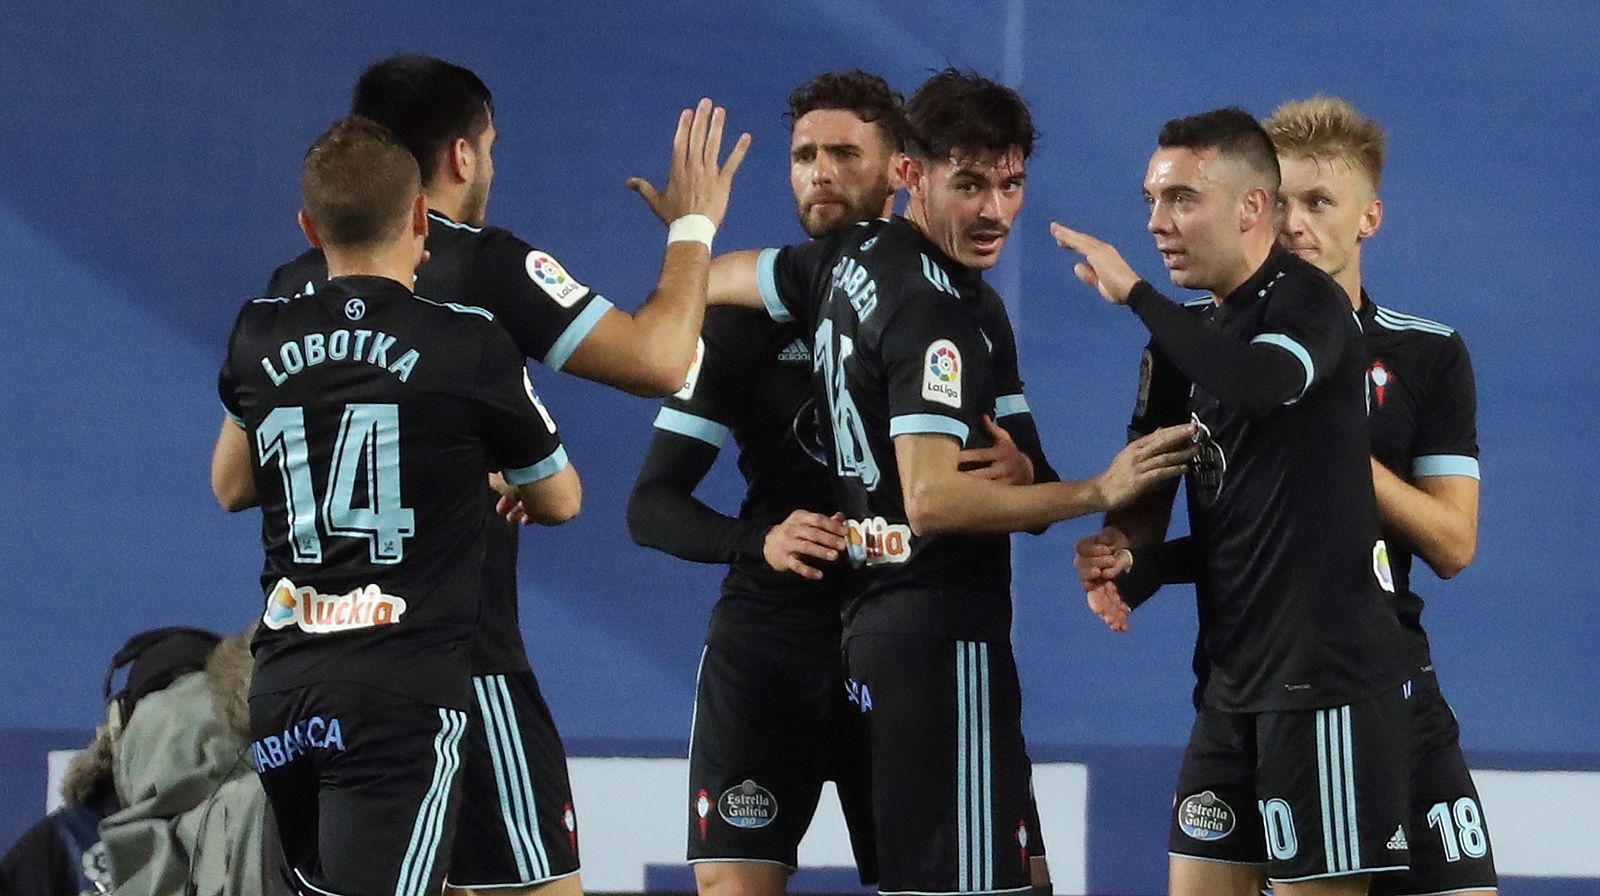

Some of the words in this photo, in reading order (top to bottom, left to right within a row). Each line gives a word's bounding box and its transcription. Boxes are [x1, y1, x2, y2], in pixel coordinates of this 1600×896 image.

[261, 329, 420, 387] LOBOTKA
[927, 382, 958, 399] LaLiga
[256, 403, 415, 565] 14
[302, 591, 394, 625] luckia
[727, 793, 769, 806] Estrella
[729, 804, 768, 818] Galicia
[1186, 801, 1228, 820] Estrella
[1185, 812, 1223, 831] Galicia
[1426, 796, 1488, 863] 18
